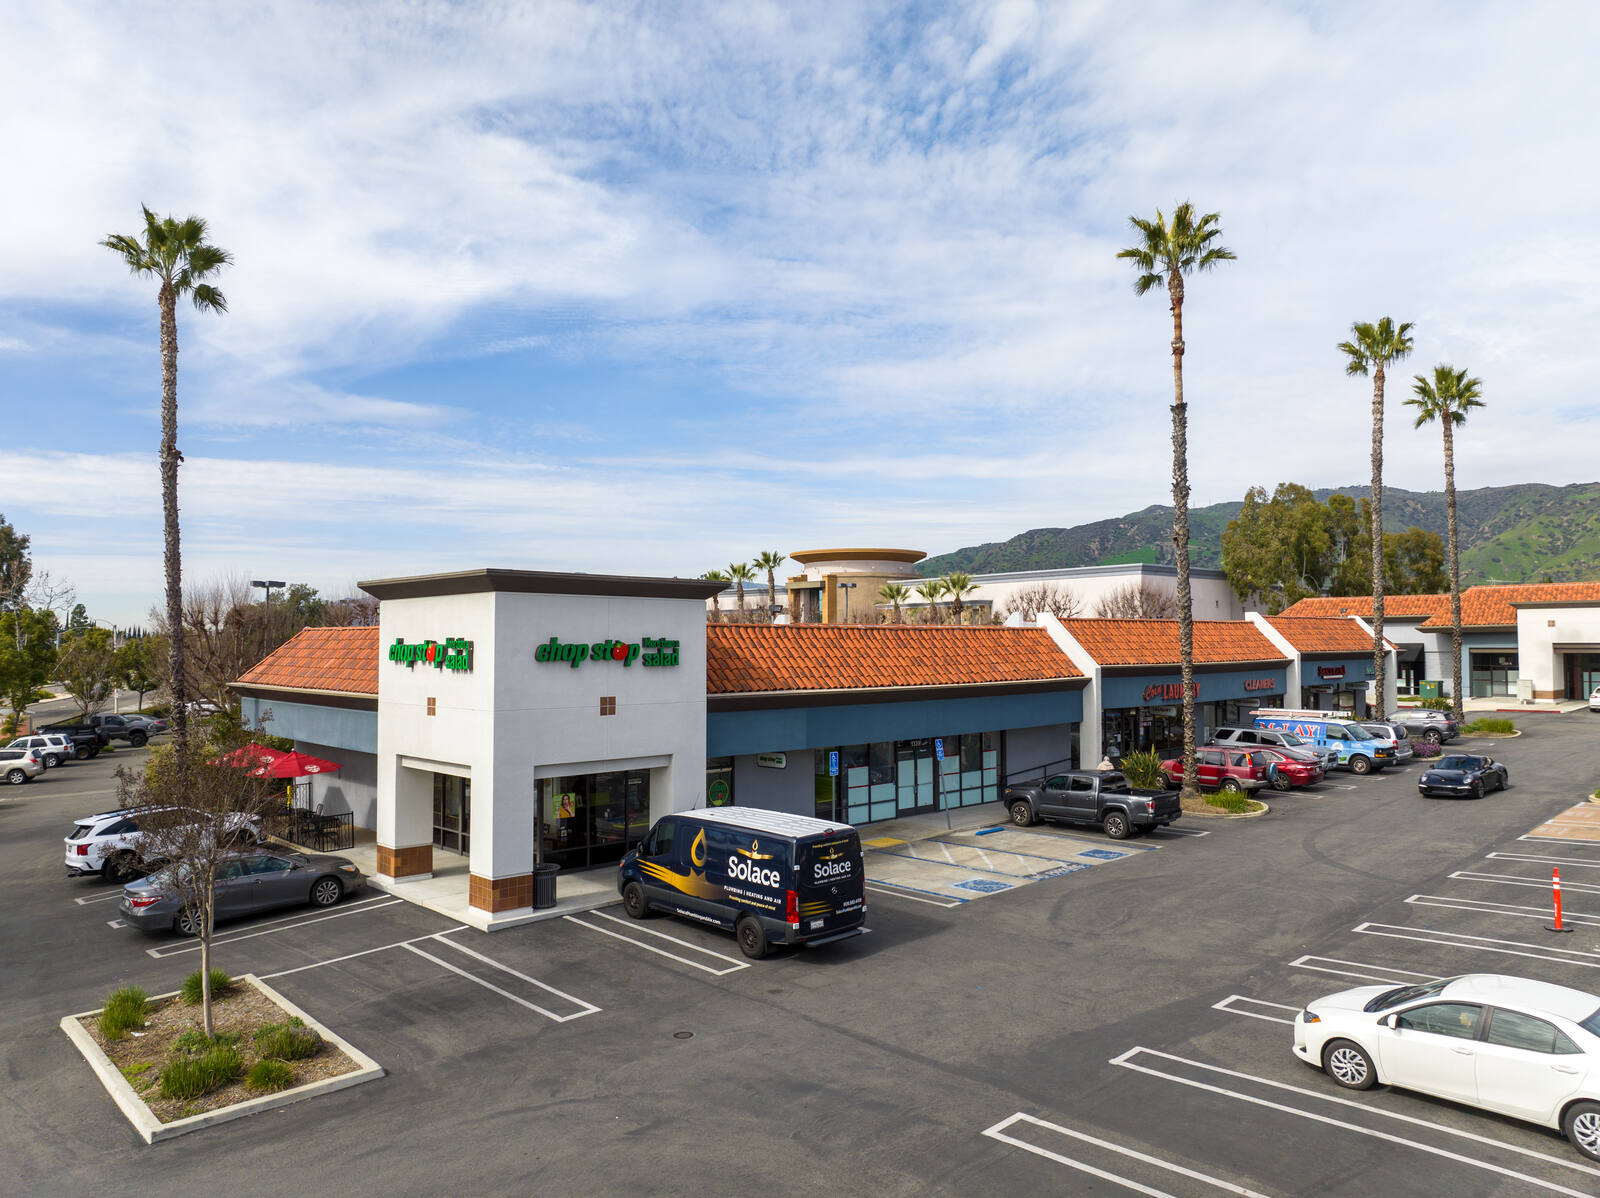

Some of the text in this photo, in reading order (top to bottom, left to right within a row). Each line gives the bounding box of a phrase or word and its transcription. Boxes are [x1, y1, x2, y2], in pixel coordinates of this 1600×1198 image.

[389, 638, 444, 668] chop stop
[445, 649, 468, 670] salad
[536, 637, 640, 668] chop stop
[643, 647, 680, 666] salad
[1163, 683, 1200, 699] LAUNRY
[1245, 678, 1276, 691] CLEANERS
[728, 856, 780, 888] Solace
[814, 860, 851, 879] Solace
[723, 885, 743, 895] PLUMBING
[745, 891, 764, 900] HEATING
[764, 895, 774, 903] AND
